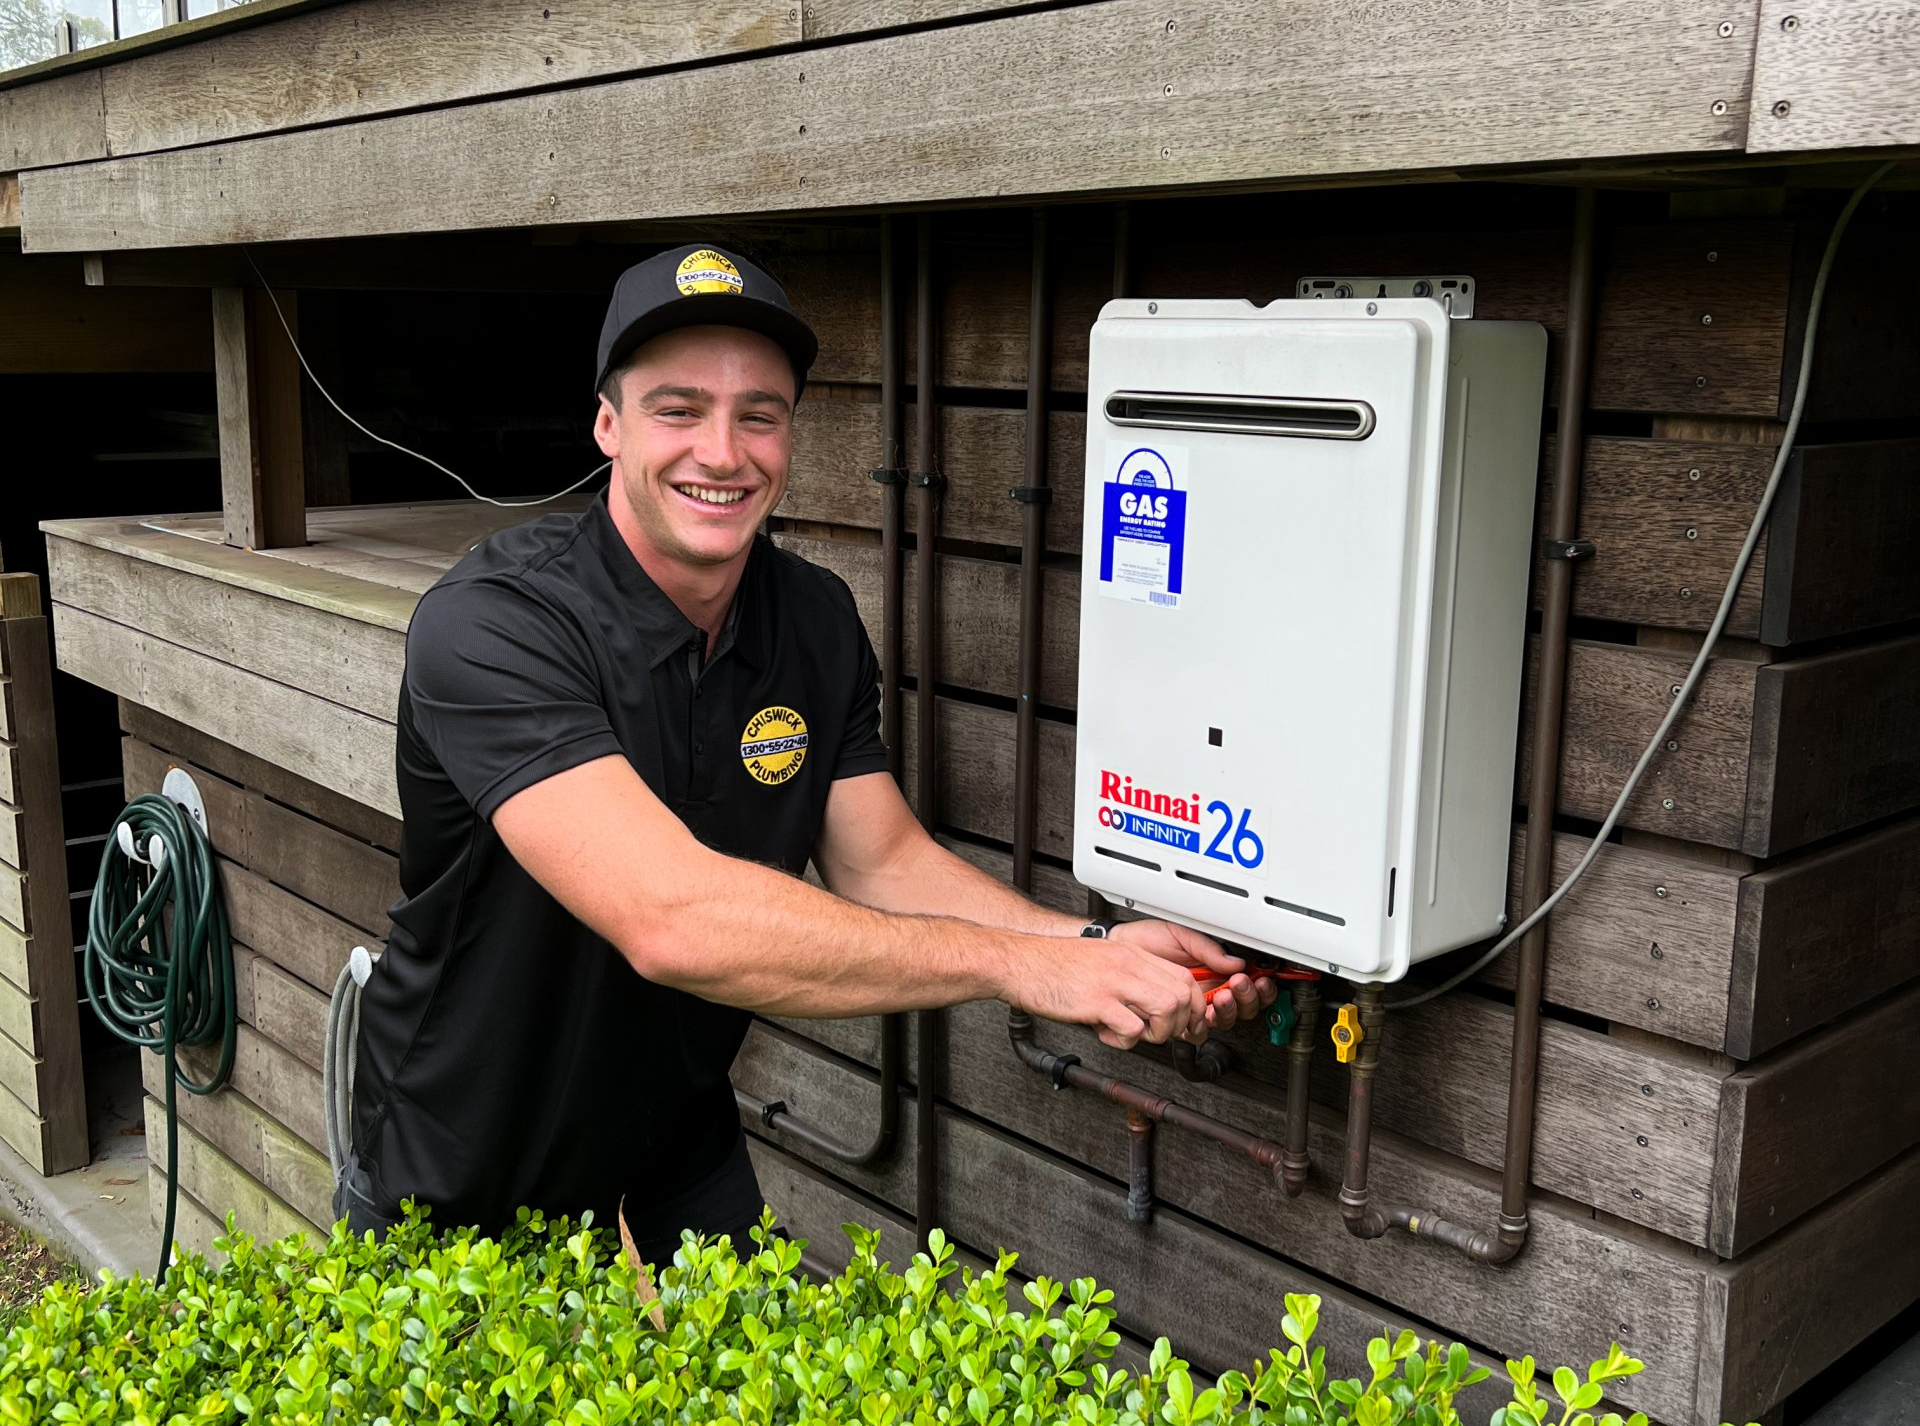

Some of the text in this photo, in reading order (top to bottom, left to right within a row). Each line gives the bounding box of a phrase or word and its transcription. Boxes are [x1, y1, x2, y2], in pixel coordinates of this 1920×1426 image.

[682, 251, 736, 271] CHISWICK
[1119, 491, 1169, 520] GAS
[1119, 515, 1167, 529] ENERGY RATING
[747, 708, 803, 738] CHISWICK
[749, 751, 803, 783] PLUMBING
[1099, 769, 1201, 826] Rinnai
[1131, 800, 1264, 869] INFINITY 26
